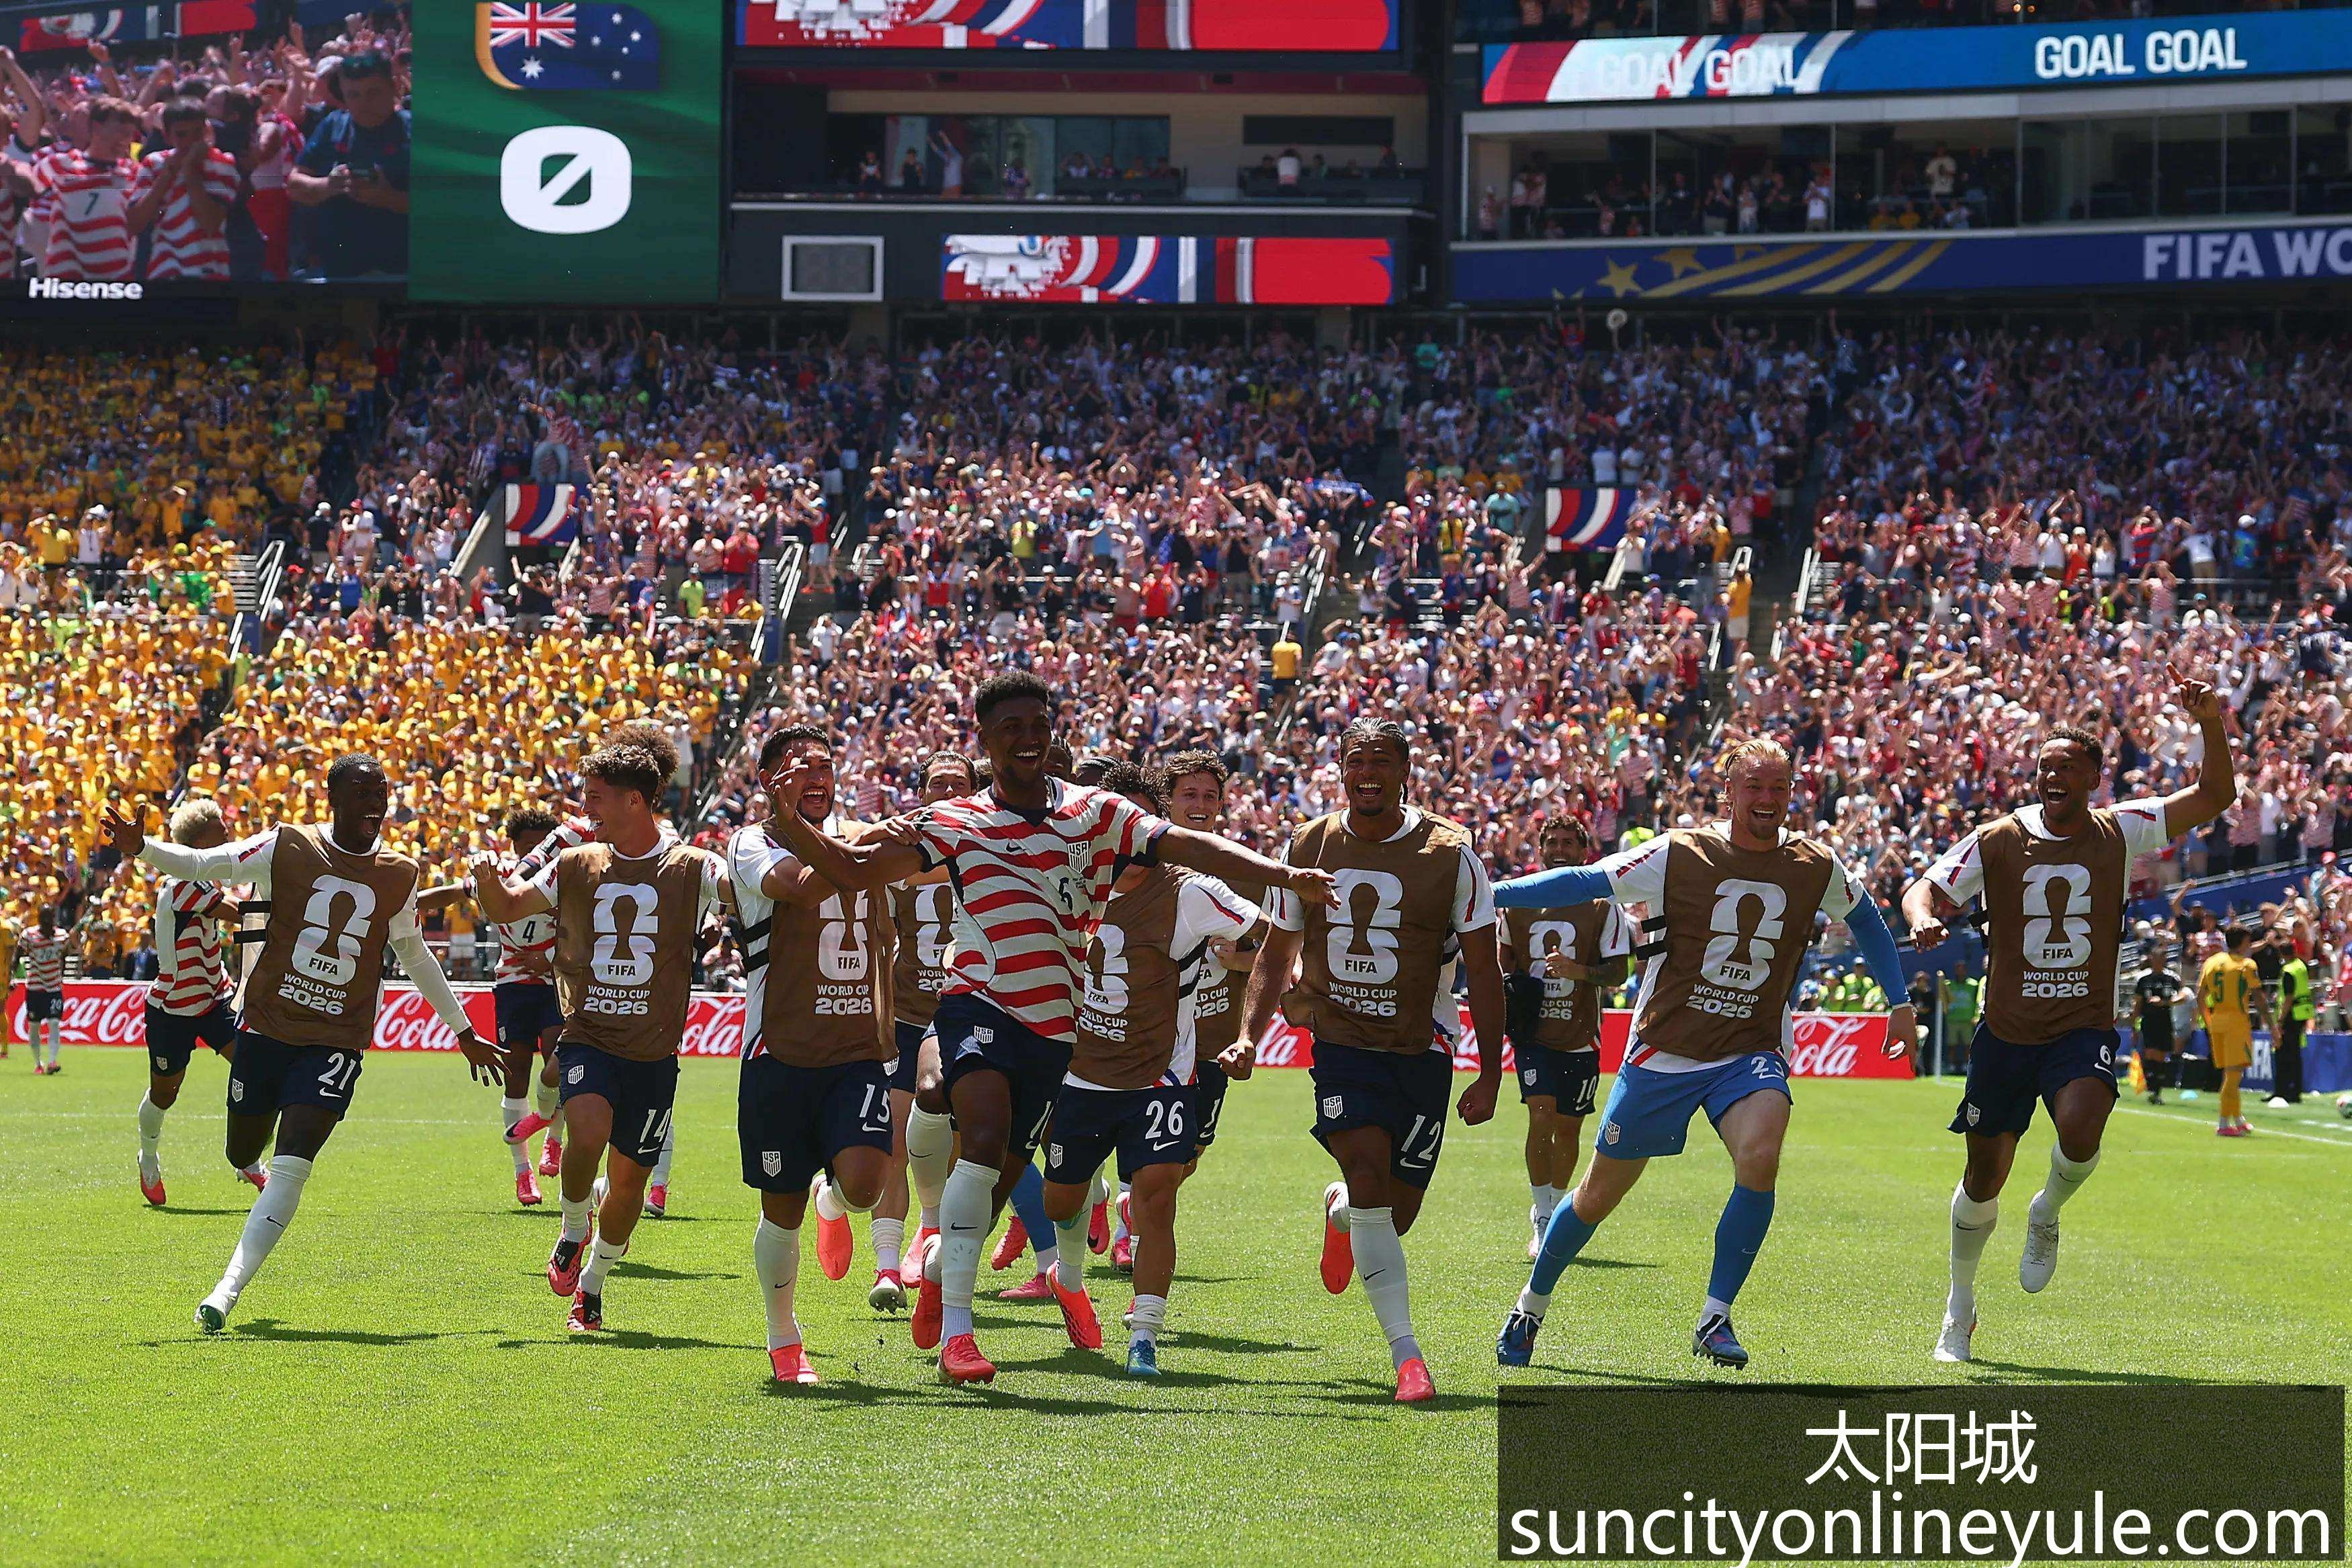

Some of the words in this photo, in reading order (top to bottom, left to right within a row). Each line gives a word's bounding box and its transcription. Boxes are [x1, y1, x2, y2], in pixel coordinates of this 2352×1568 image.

[2035, 33, 2136, 79] GOAL
[2145, 27, 2248, 74] GOAL
[1706, 45, 1800, 89] GOAL
[2144, 232, 2265, 280] FIFA
[29, 277, 144, 300] Hisense
[1068, 842, 1087, 856] USA
[523, 920, 536, 943] 4
[838, 957, 860, 969] FIFA
[2043, 948, 2073, 959] FIFA
[309, 957, 339, 975] FIFA
[607, 965, 636, 975] FIFA
[1345, 959, 1378, 973] FIFA
[1720, 965, 1751, 981] FIFA
[918, 979, 946, 992] 20
[2023, 971, 2065, 981] WORLD
[2067, 971, 2089, 980] CUP
[284, 973, 324, 994] WORLD
[326, 988, 347, 1000] CUP
[588, 985, 627, 998] WORLD
[629, 990, 650, 998] CUP
[817, 985, 853, 996] WORLD
[855, 985, 869, 995] CUP
[1210, 987, 1228, 999] CUP
[1329, 982, 1369, 997] WORLD
[1371, 989, 1397, 998] CUP
[1693, 984, 1735, 1000] WORLD
[1736, 994, 1759, 1004] CUP
[2022, 982, 2089, 998] 2026
[2214, 971, 2224, 1003] 5
[278, 984, 344, 1015] 2026
[583, 996, 648, 1015] 2026
[815, 998, 872, 1015] 2026
[1194, 998, 1229, 1019] 026
[1685, 996, 1753, 1018] 2026
[1081, 1008, 1102, 1023] ORLD
[1104, 1017, 1128, 1027] CUP
[1539, 1008, 1572, 1020] 026
[974, 1025, 993, 1035] USA
[1078, 1016, 1126, 1042] 026
[2100, 1045, 2111, 1065] 6
[317, 1053, 356, 1090] 21
[1577, 1075, 1597, 1102] 10
[859, 1084, 890, 1123] 15
[1325, 1096, 1341, 1106] USA
[640, 1108, 671, 1143] 14
[1144, 1100, 1183, 1139] 26
[1401, 1115, 1441, 1161] 12
[763, 1152, 780, 1162] USA
